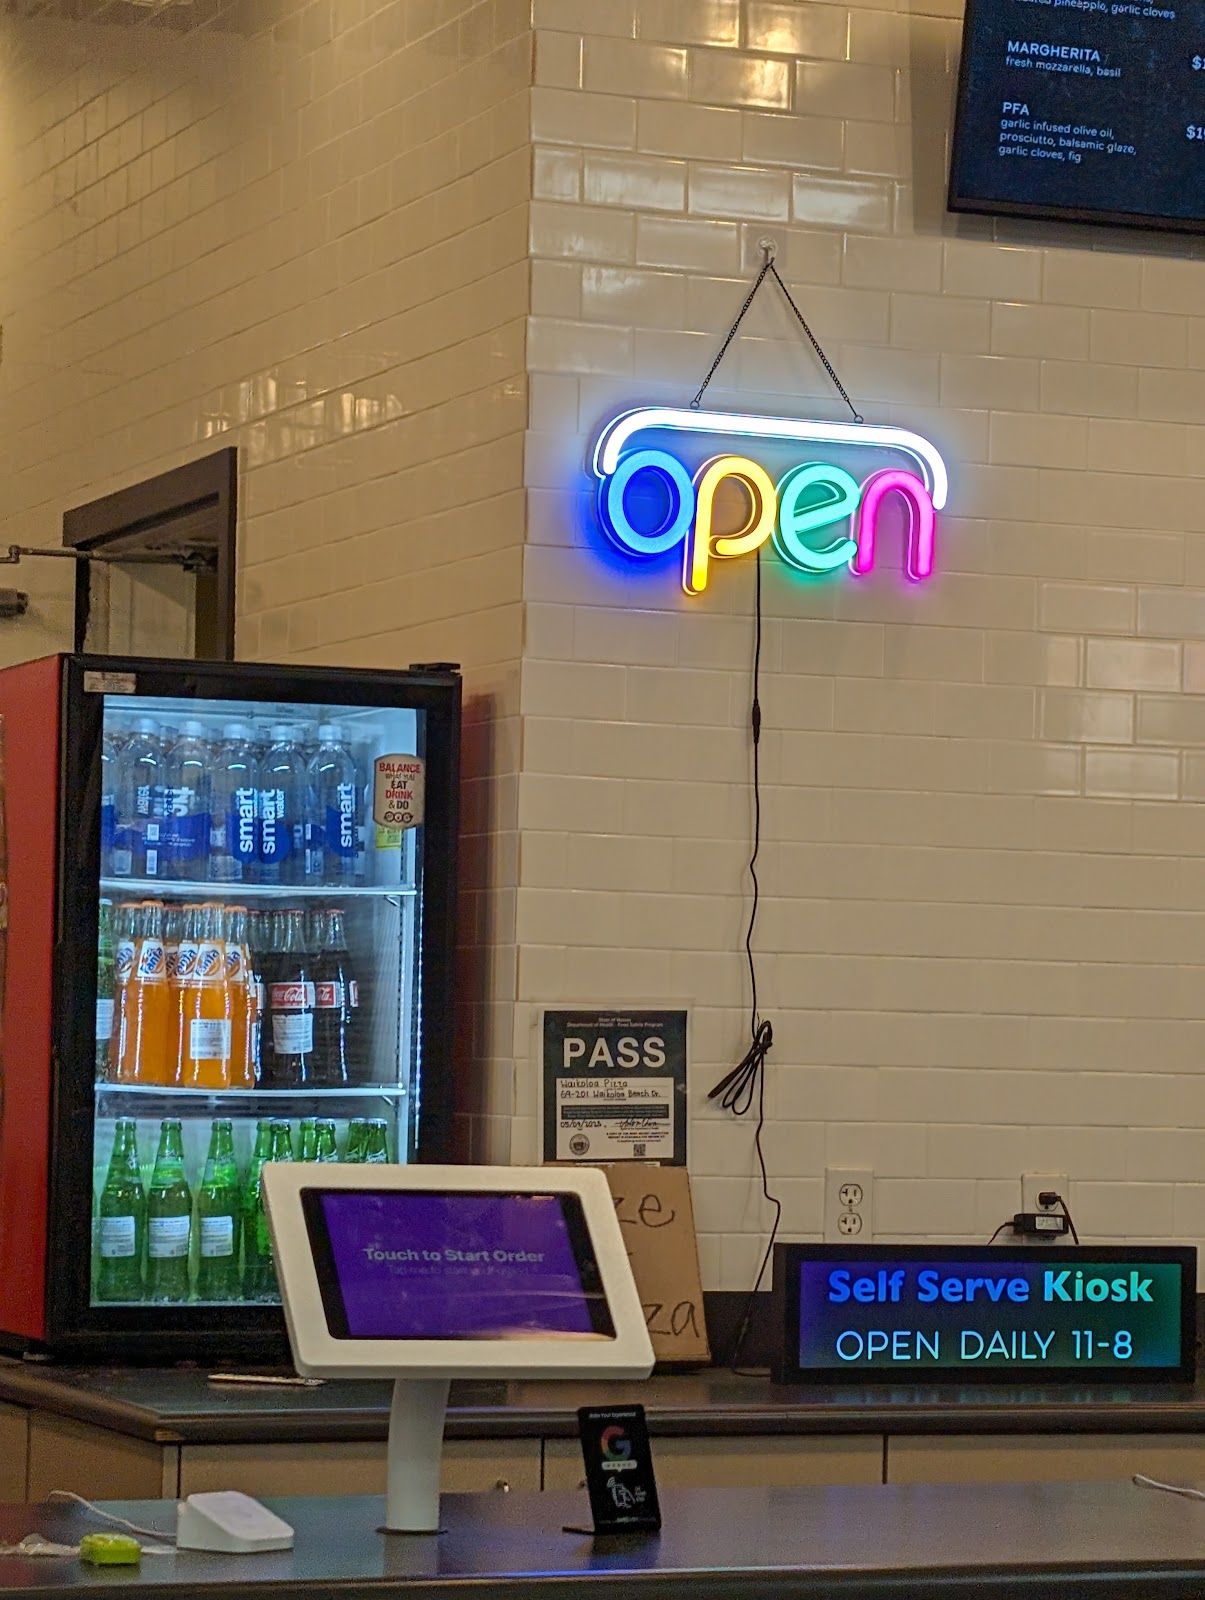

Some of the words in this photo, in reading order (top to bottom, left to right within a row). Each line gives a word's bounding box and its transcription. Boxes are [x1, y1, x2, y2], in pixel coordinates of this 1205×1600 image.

[1111, 4, 1140, 17] garlic
[1143, 7, 1176, 19] cloves
[1007, 41, 1101, 62] MARGHERITA
[1005, 56, 1033, 68] fresh
[1035, 60, 1094, 77] mozzarella,
[1096, 66, 1121, 77] basil
[1002, 102, 1030, 116] PFA
[1000, 119, 1031, 131] garlic
[1033, 121, 1071, 134] infused
[1073, 125, 1097, 137] olive
[1099, 128, 1115, 140] oil,
[1186, 125, 1205, 140] $1
[999, 133, 1056, 147] prosciutto,
[1059, 137, 1105, 151] balsamic
[1106, 142, 1138, 155] glaze,
[998, 146, 1028, 158] garlic
[1030, 148, 1066, 162] cloves,
[1068, 152, 1082, 164] fig
[602, 448, 935, 594] open
[379, 762, 421, 774] BALANCE
[385, 790, 414, 800] DRINK
[391, 780, 408, 790] EAT
[276, 789, 285, 819] water
[397, 801, 409, 810] DO
[236, 787, 253, 853] smart
[261, 789, 276, 855] smart
[337, 783, 352, 848] smart
[563, 1036, 666, 1068] PASS
[560, 1078, 600, 1088] Waikoloa
[363, 1248, 420, 1261] Touch
[422, 1249, 441, 1261] to
[445, 1249, 490, 1262] Start
[493, 1249, 545, 1262] Order
[828, 1270, 905, 1303] Self
[917, 1270, 1030, 1303] Serve
[1044, 1270, 1154, 1302] Kiosk
[835, 1330, 940, 1361] OPEN
[960, 1330, 1056, 1360] DAILY
[1071, 1330, 1134, 1360] 11-8
